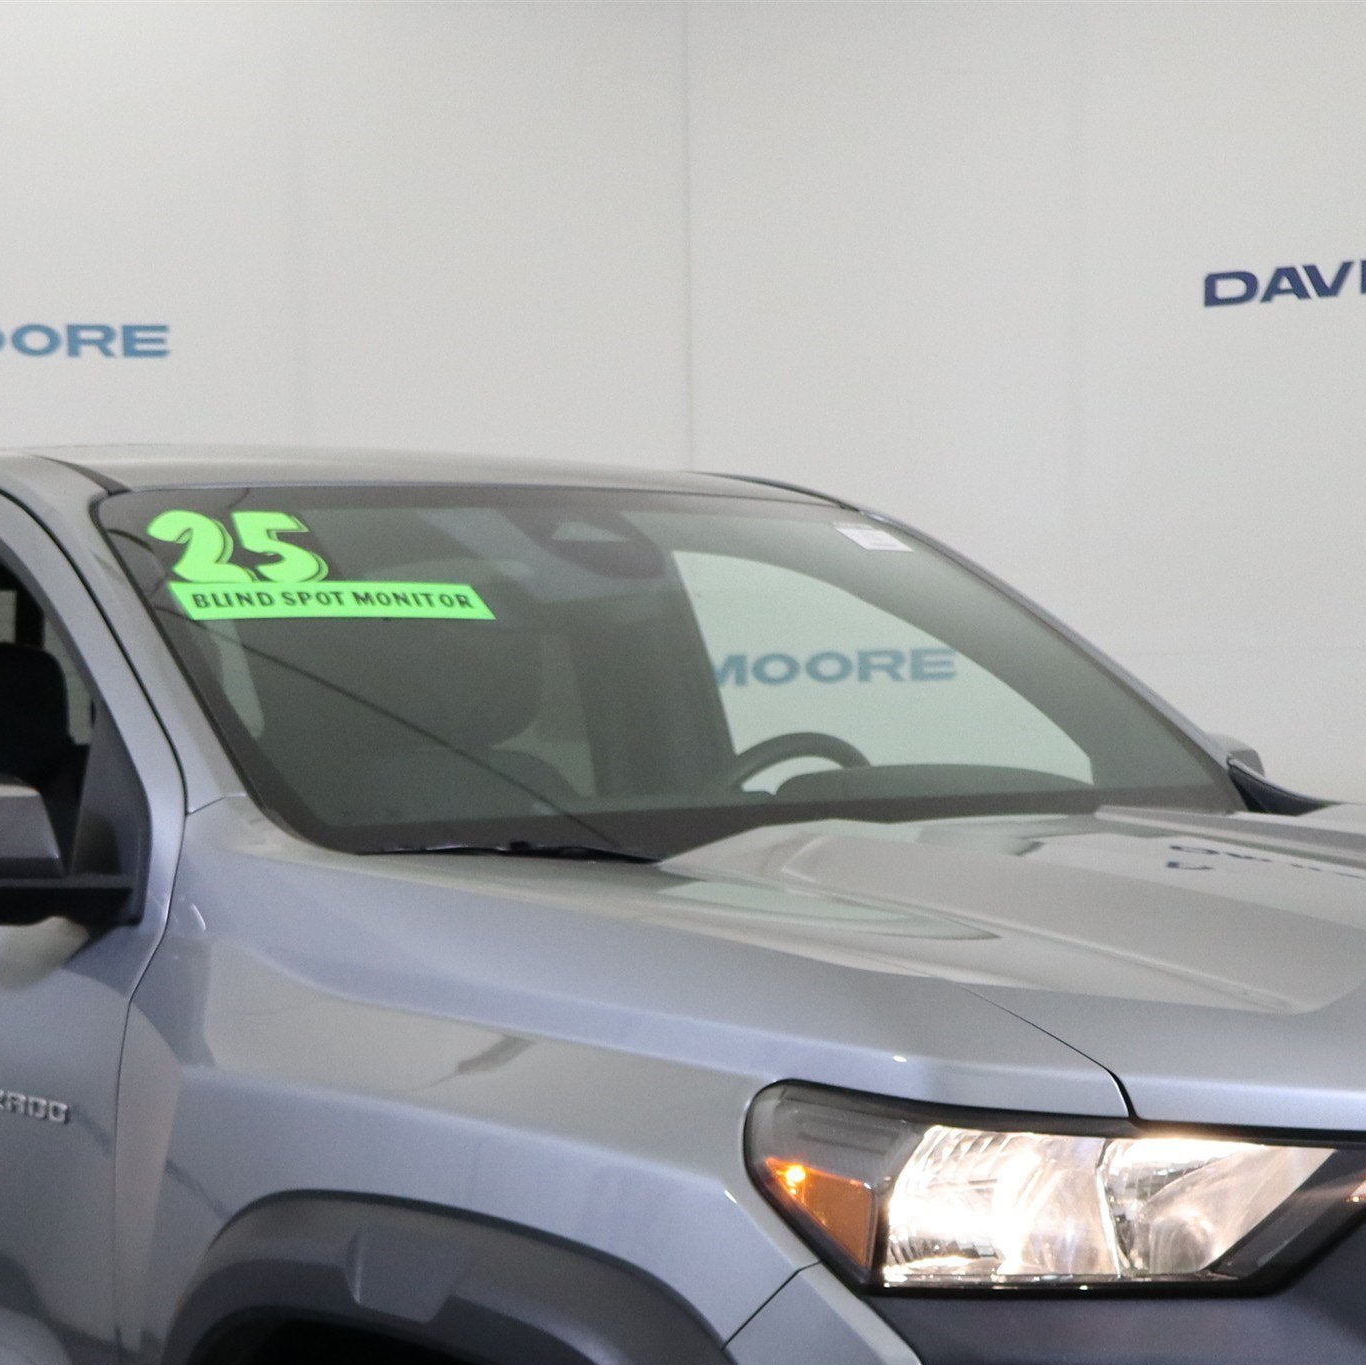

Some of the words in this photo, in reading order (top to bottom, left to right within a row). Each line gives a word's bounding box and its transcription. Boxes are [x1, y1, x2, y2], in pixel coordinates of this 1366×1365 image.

[146, 509, 329, 583] 25
[191, 591, 276, 610] BLIND
[281, 590, 345, 607] SPOT
[353, 590, 476, 610] MONITOR
